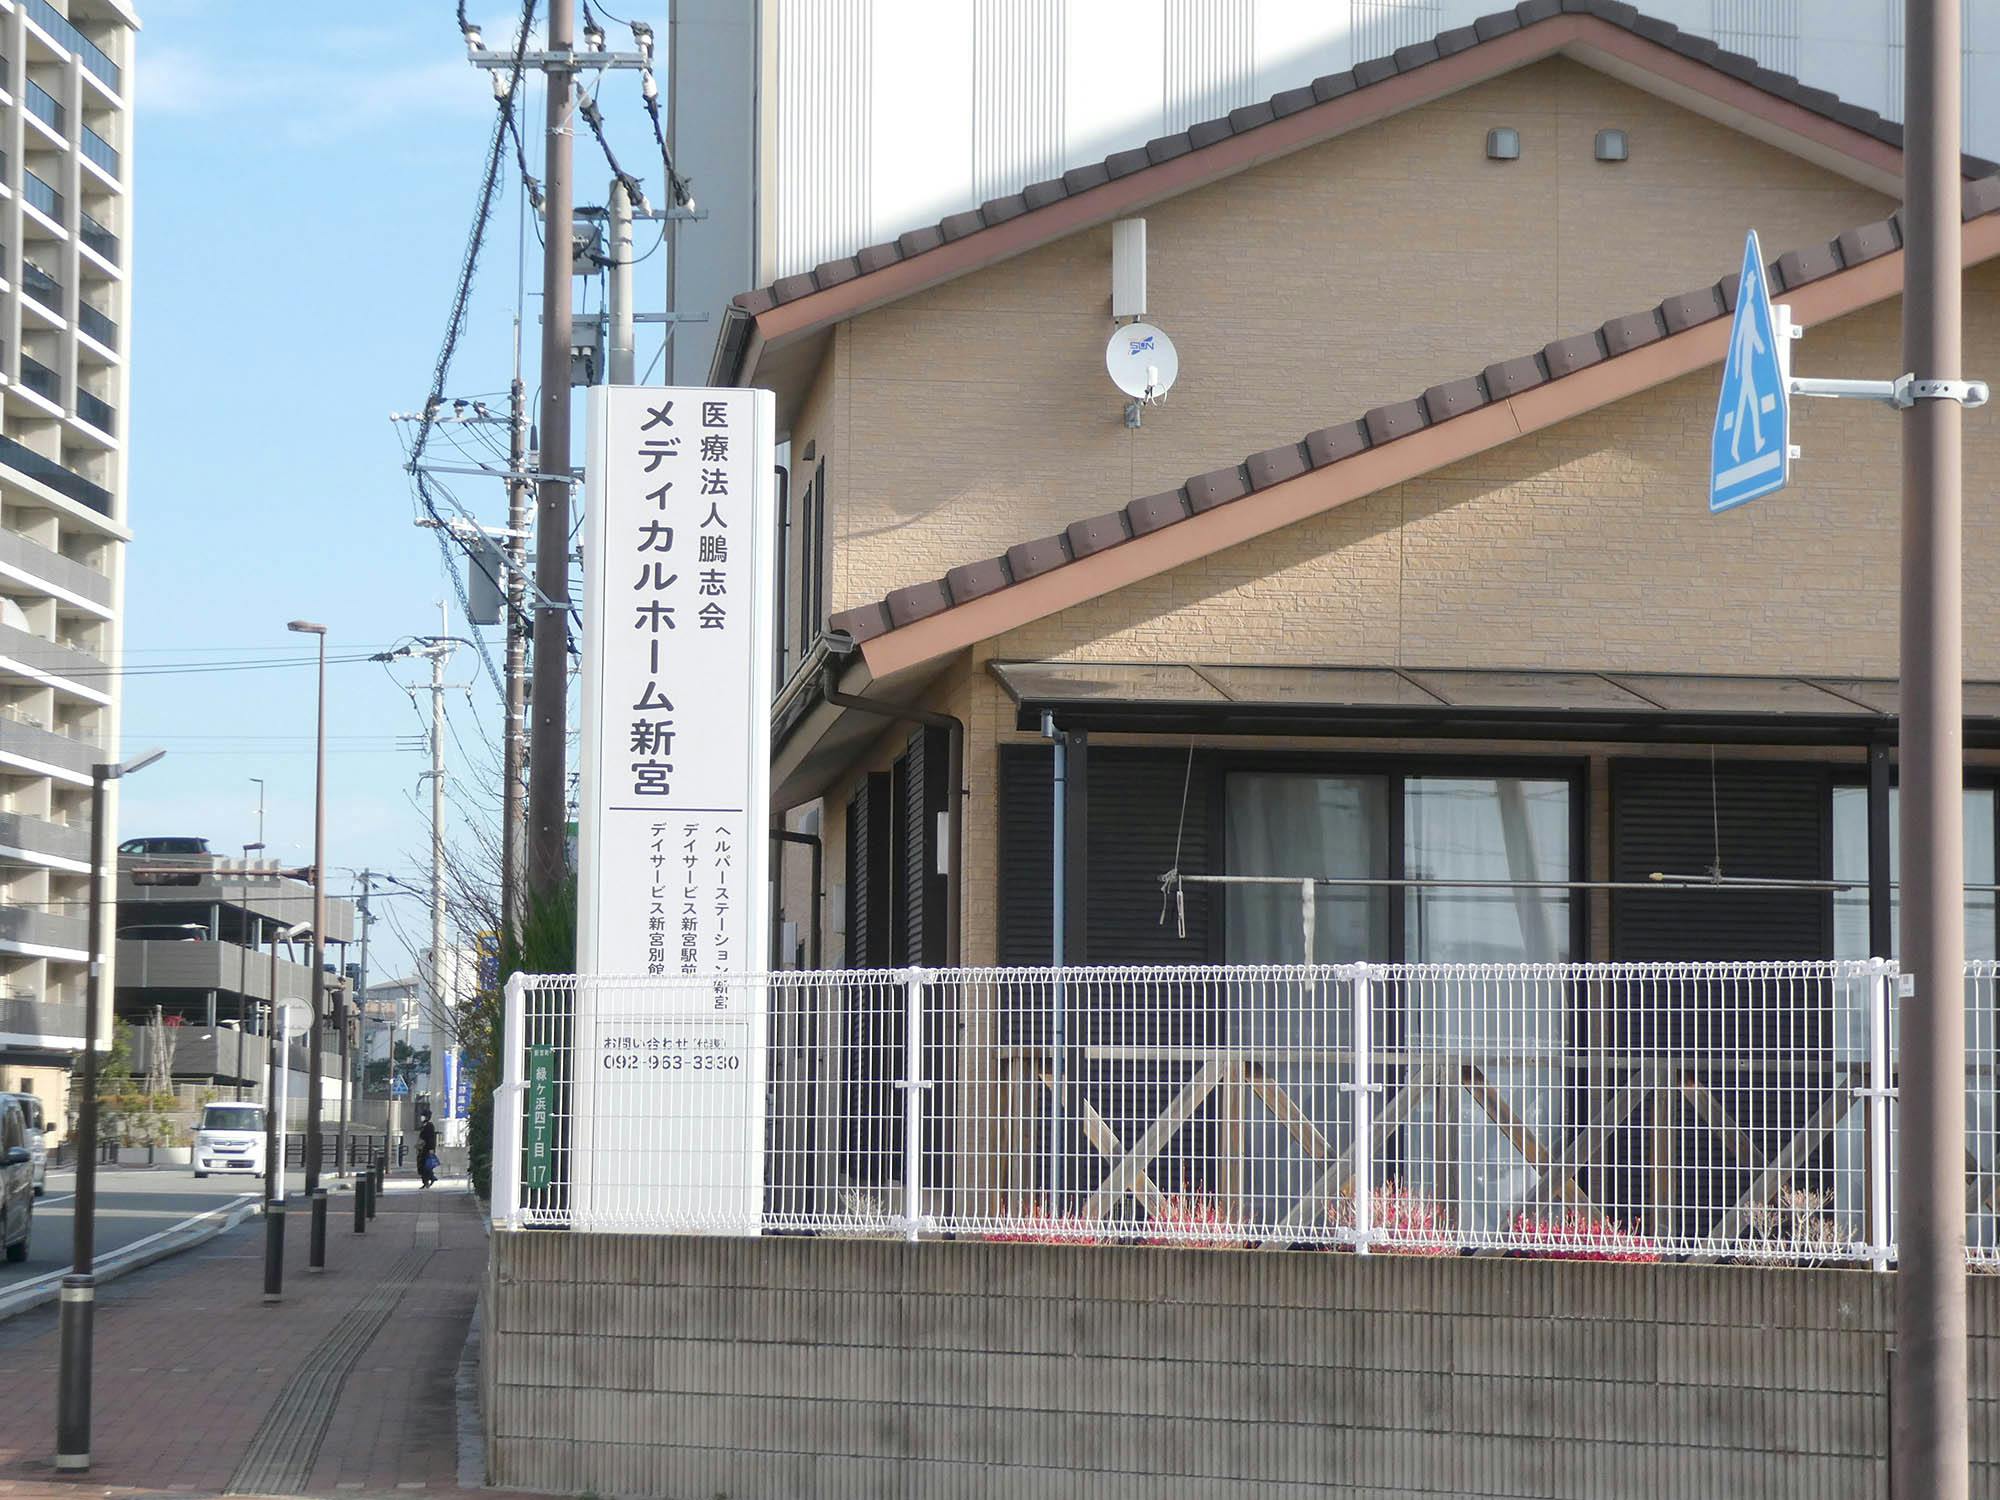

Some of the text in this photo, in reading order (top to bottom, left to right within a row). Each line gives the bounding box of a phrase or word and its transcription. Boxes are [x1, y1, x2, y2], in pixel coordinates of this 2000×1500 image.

[698, 401, 729, 630] 医療法人鵬志会
[630, 400, 680, 796] メディカルホーム新宮
[648, 822, 667, 979] デイサービス新宮別館
[603, 1055, 739, 1070] 092-963-3330
[532, 1165, 547, 1184] 17
